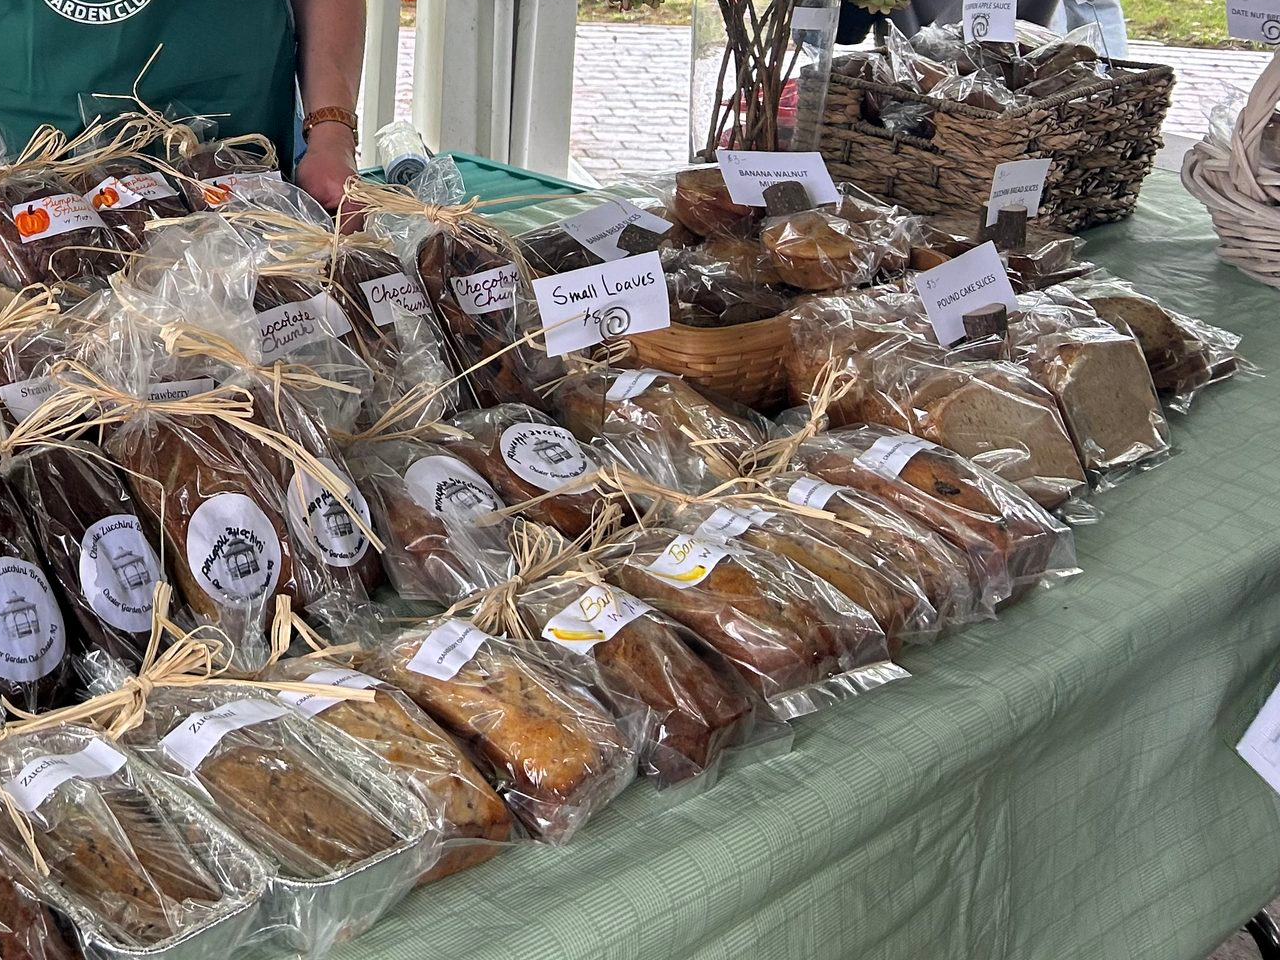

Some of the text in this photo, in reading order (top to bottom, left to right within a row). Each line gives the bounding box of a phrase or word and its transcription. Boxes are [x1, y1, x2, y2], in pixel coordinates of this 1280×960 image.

[993, 2, 1011, 10] SAUCE
[1231, 8, 1249, 17] DATE
[1250, 11, 1266, 19] NUT
[738, 169, 773, 177] BANANA
[606, 222, 625, 236] BREAD
[456, 270, 520, 296] Chocolate
[552, 271, 656, 305] Small Loaves
[936, 273, 997, 309] POUND CAKE SLICES
[261, 310, 316, 337] ocolate
[262, 323, 315, 353] Chunk
[147, 388, 190, 400] rawberry
[99, 519, 134, 536] Zucchini
[103, 587, 121, 608] Chester
[121, 603, 142, 613] Garden
[4, 652, 29, 664] Garden
